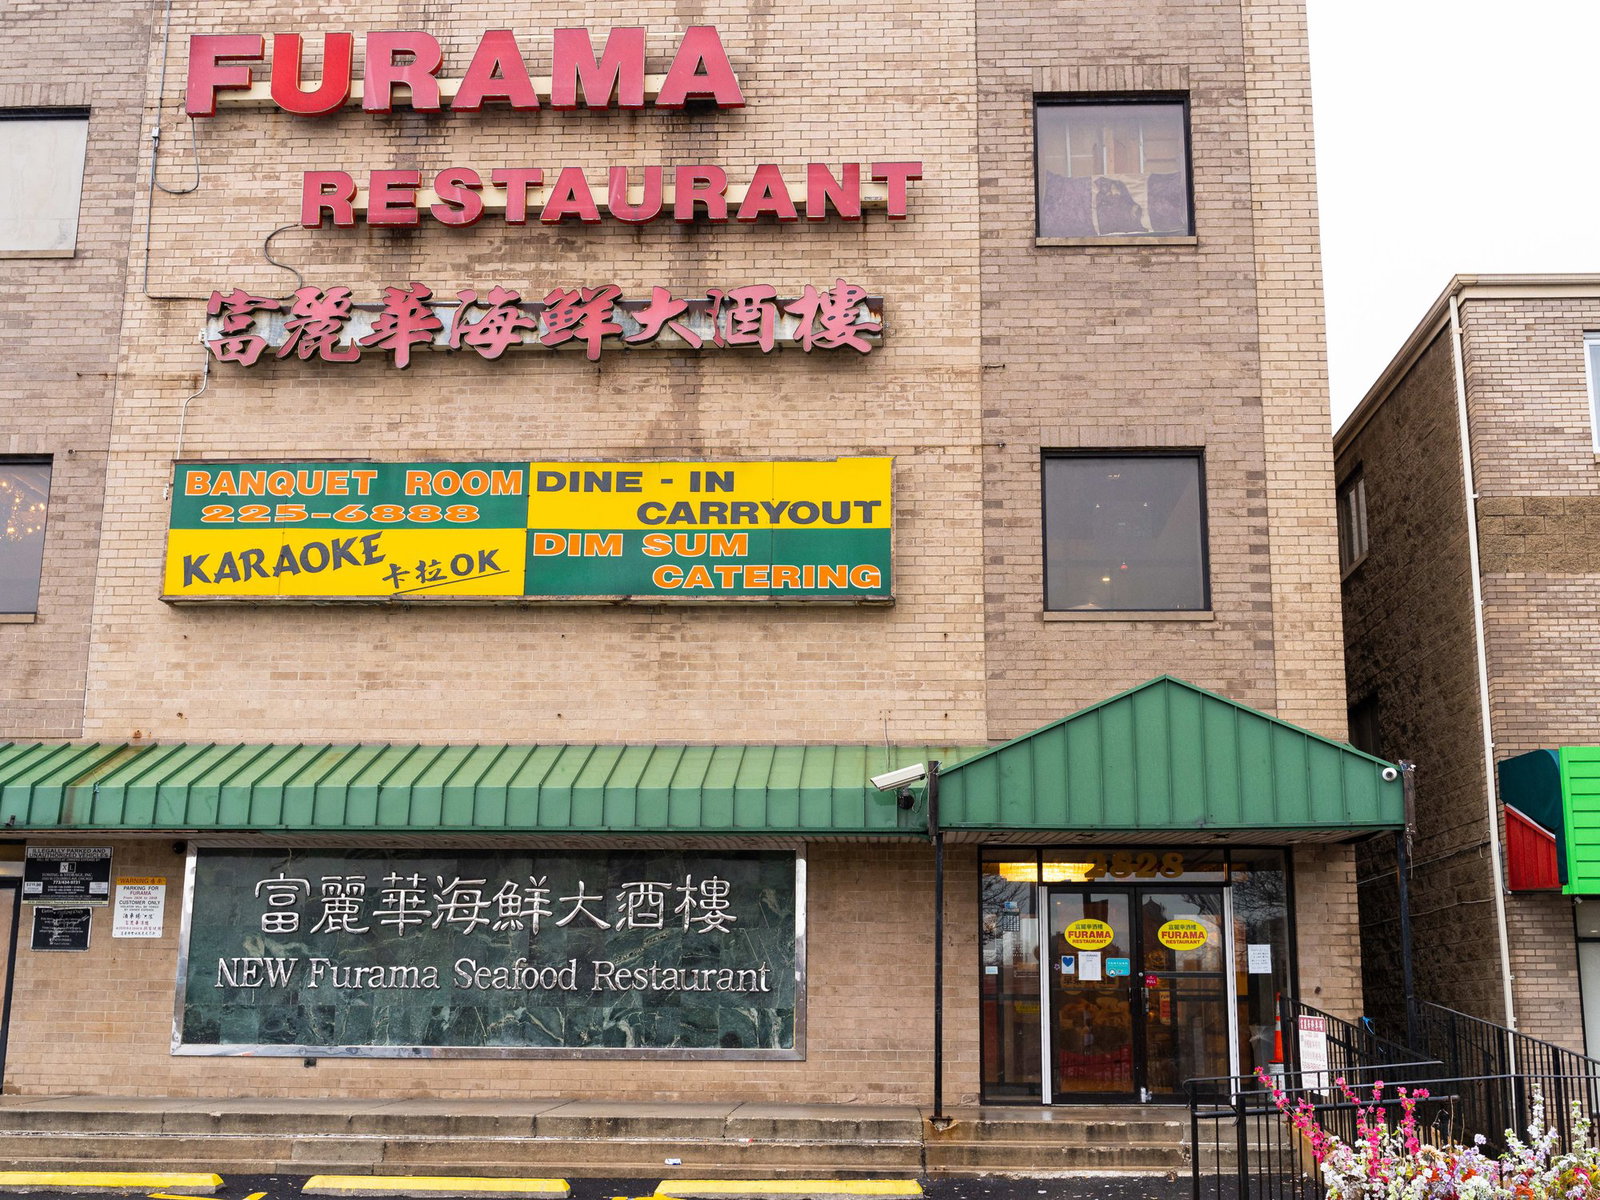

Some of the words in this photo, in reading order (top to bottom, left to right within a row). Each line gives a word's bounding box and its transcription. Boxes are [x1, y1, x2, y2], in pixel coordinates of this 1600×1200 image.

[185, 25, 746, 118] FURAMA
[302, 161, 923, 229] RESTAURANT
[206, 278, 883, 370] 富麗華海鮮大酒樓
[184, 469, 378, 498] BANQUET
[404, 469, 524, 496] ROOM
[536, 471, 643, 492] DINE
[689, 471, 735, 492] IN
[200, 504, 480, 523] 225-6888
[636, 500, 881, 525] CARRYOUT
[533, 532, 623, 557] DIM
[641, 532, 749, 557] SUM
[183, 531, 386, 588] KARAOKE
[382, 548, 501, 589] 卡拉OK
[652, 564, 882, 589] CATERING
[1084, 851, 1184, 878] 2828
[254, 872, 738, 937] 富麗華海鮮大酒樓
[1161, 931, 1205, 939] FURAMA
[214, 957, 299, 990] NEW
[308, 957, 440, 991] Furama
[454, 957, 577, 991] Seafood
[592, 959, 773, 993] Restaurant
